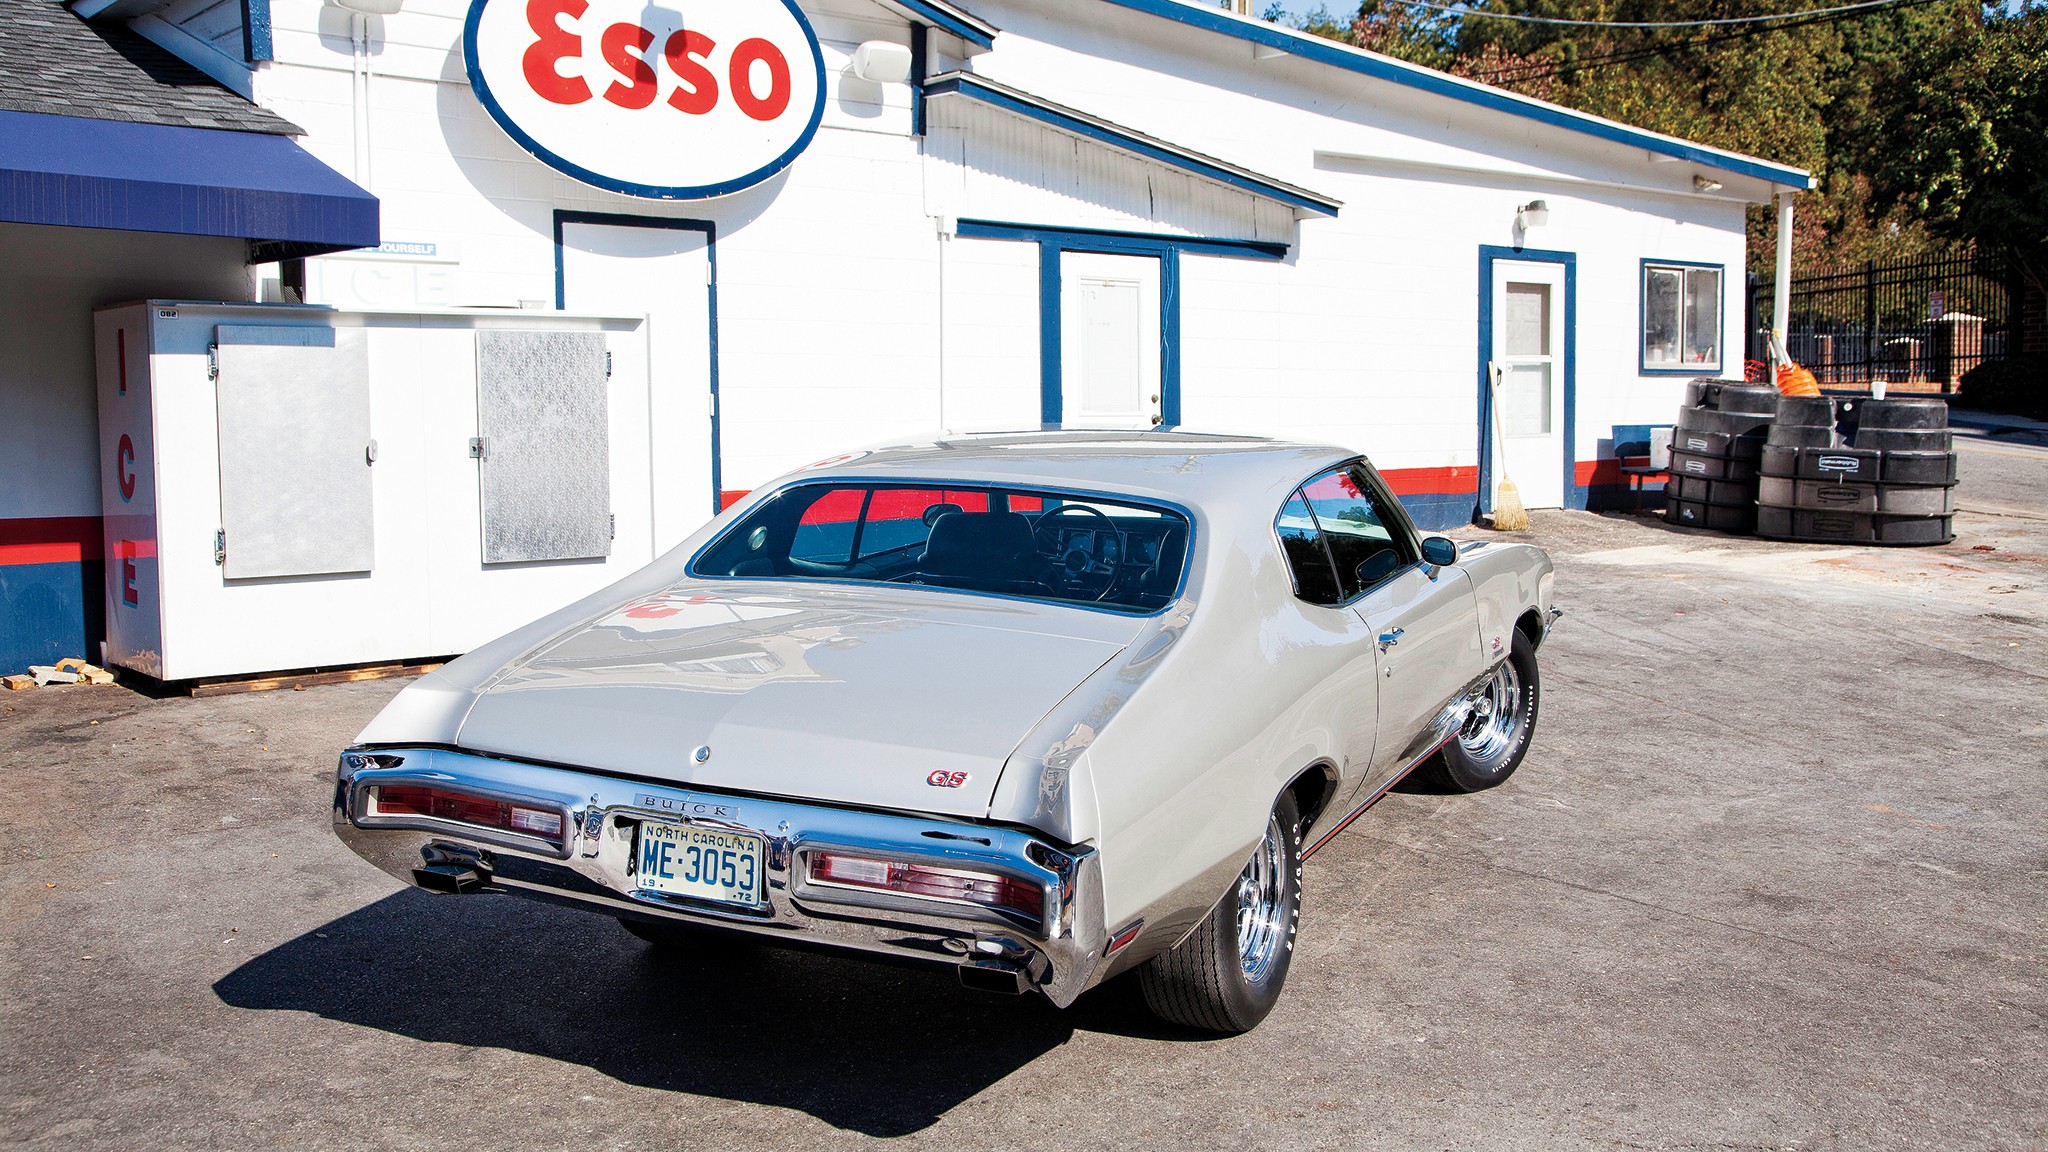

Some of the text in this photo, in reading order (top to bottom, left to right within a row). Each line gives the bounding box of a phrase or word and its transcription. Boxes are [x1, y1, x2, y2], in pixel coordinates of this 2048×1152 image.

[116, 328, 139, 608] ICE
[927, 769, 968, 788] GS
[644, 796, 727, 816] BUICK
[646, 826, 755, 852] NORTH CAROLINA
[642, 879, 752, 901] 19 72
[1287, 824, 1302, 951] GOODYEAR
